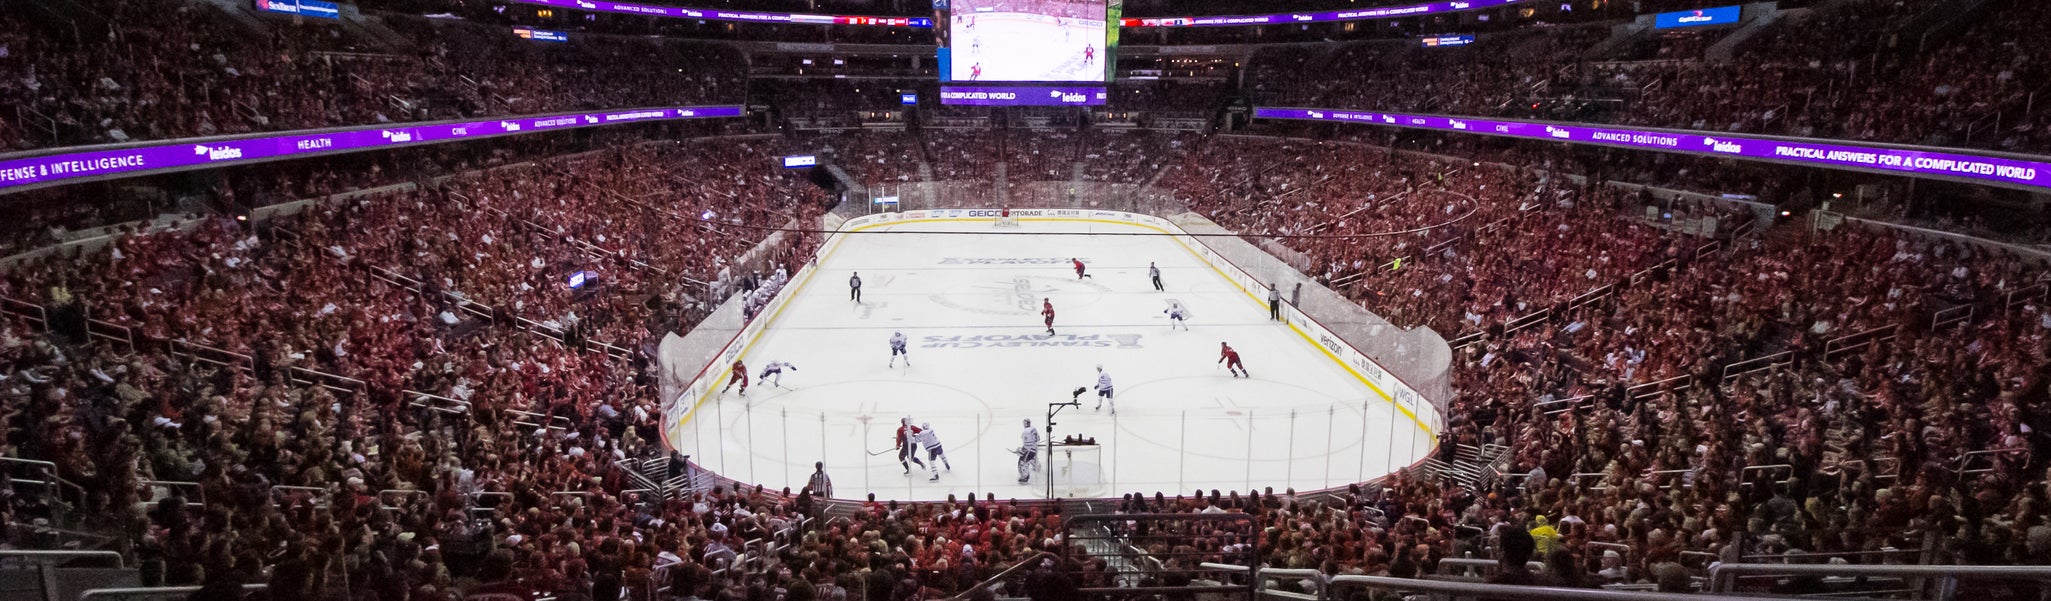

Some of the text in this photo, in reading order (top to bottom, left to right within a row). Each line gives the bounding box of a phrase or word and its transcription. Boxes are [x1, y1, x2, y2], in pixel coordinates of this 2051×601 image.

[988, 92, 1016, 100] WORLD
[1062, 92, 1087, 102] leidos
[391, 131, 411, 142] leidos
[452, 127, 467, 135] CIVIL
[1552, 127, 1570, 138] leidos
[297, 138, 331, 150] HEALTH
[1592, 132, 1679, 147] ADVANCED SOLUTIONS
[1713, 139, 1742, 154] leidos
[209, 146, 242, 160] leidos
[40, 162, 48, 175] &
[51, 155, 144, 174] INTELLIGENCE
[1776, 145, 2036, 180] PRACTICAL ANSWERS FOR A COMPLICATED WORLD
[922, 334, 1100, 342] PLAYOFFS
[920, 341, 983, 349] CUP
[1320, 333, 1343, 357] verizon
[1399, 386, 1415, 406] WGL
